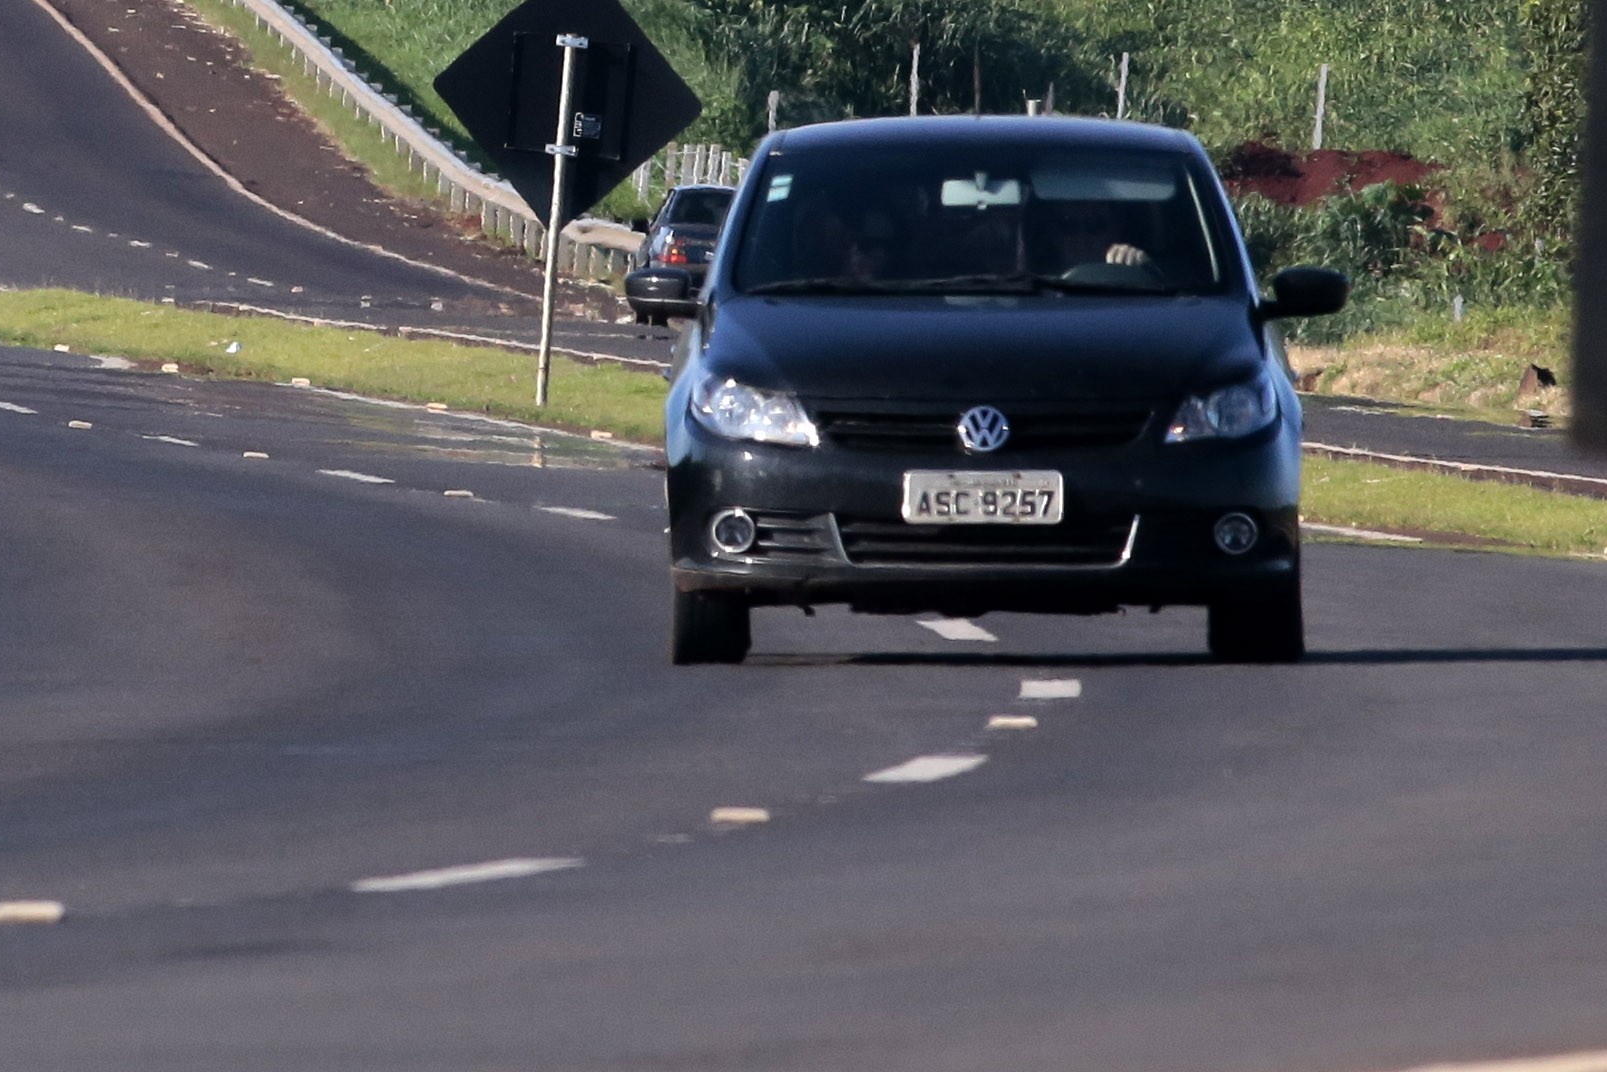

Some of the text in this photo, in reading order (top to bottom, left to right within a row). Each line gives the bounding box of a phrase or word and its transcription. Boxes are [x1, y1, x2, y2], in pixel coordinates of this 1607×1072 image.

[958, 405, 1009, 451] VW
[917, 490, 1055, 517] ASC 9257
